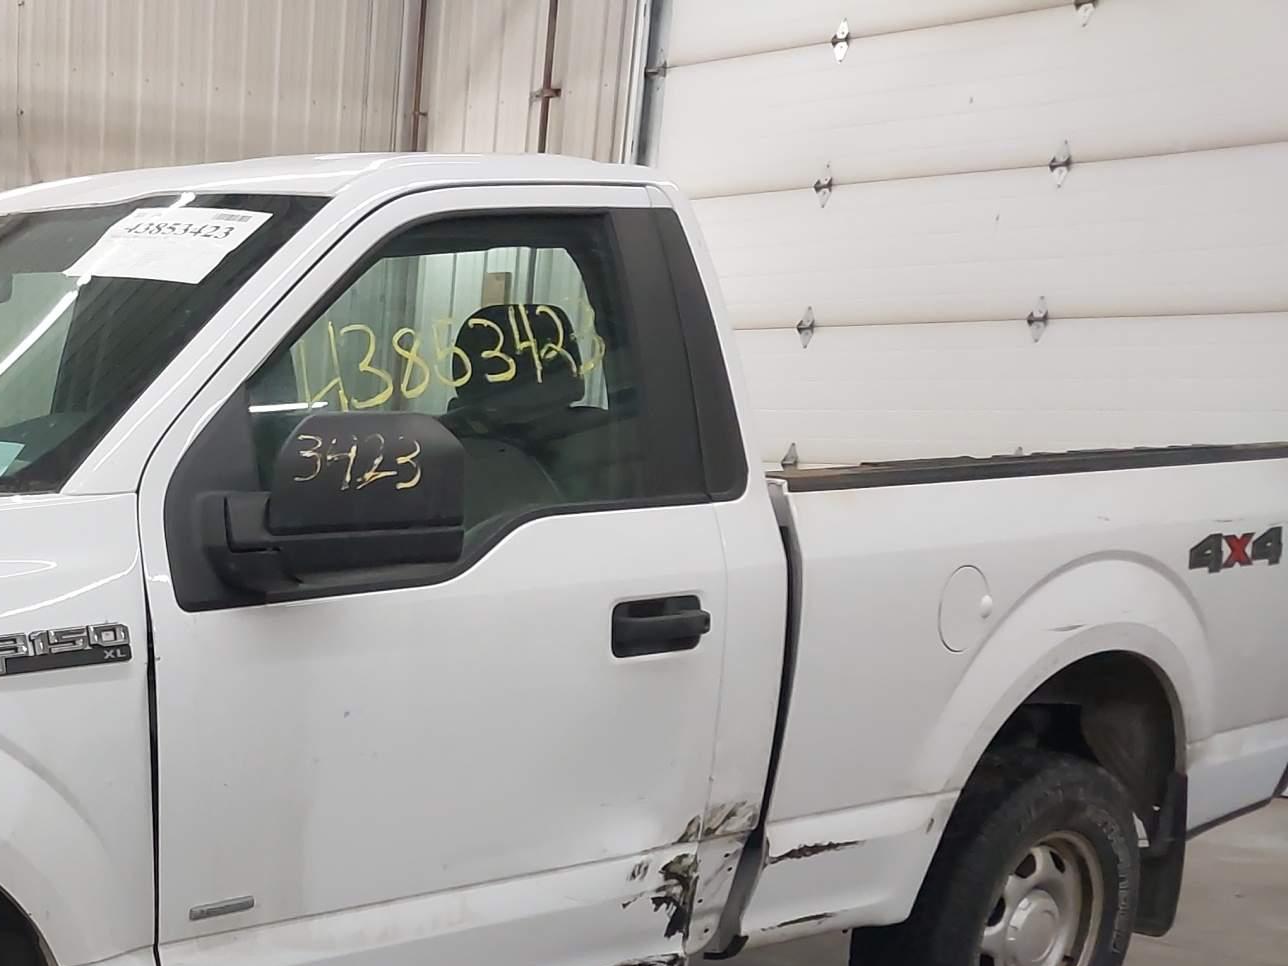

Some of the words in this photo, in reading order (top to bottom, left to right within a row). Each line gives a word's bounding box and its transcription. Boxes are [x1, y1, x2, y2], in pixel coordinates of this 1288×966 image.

[296, 302, 606, 413] 43853423
[293, 432, 422, 490] 3423
[103, 648, 128, 660] XL
